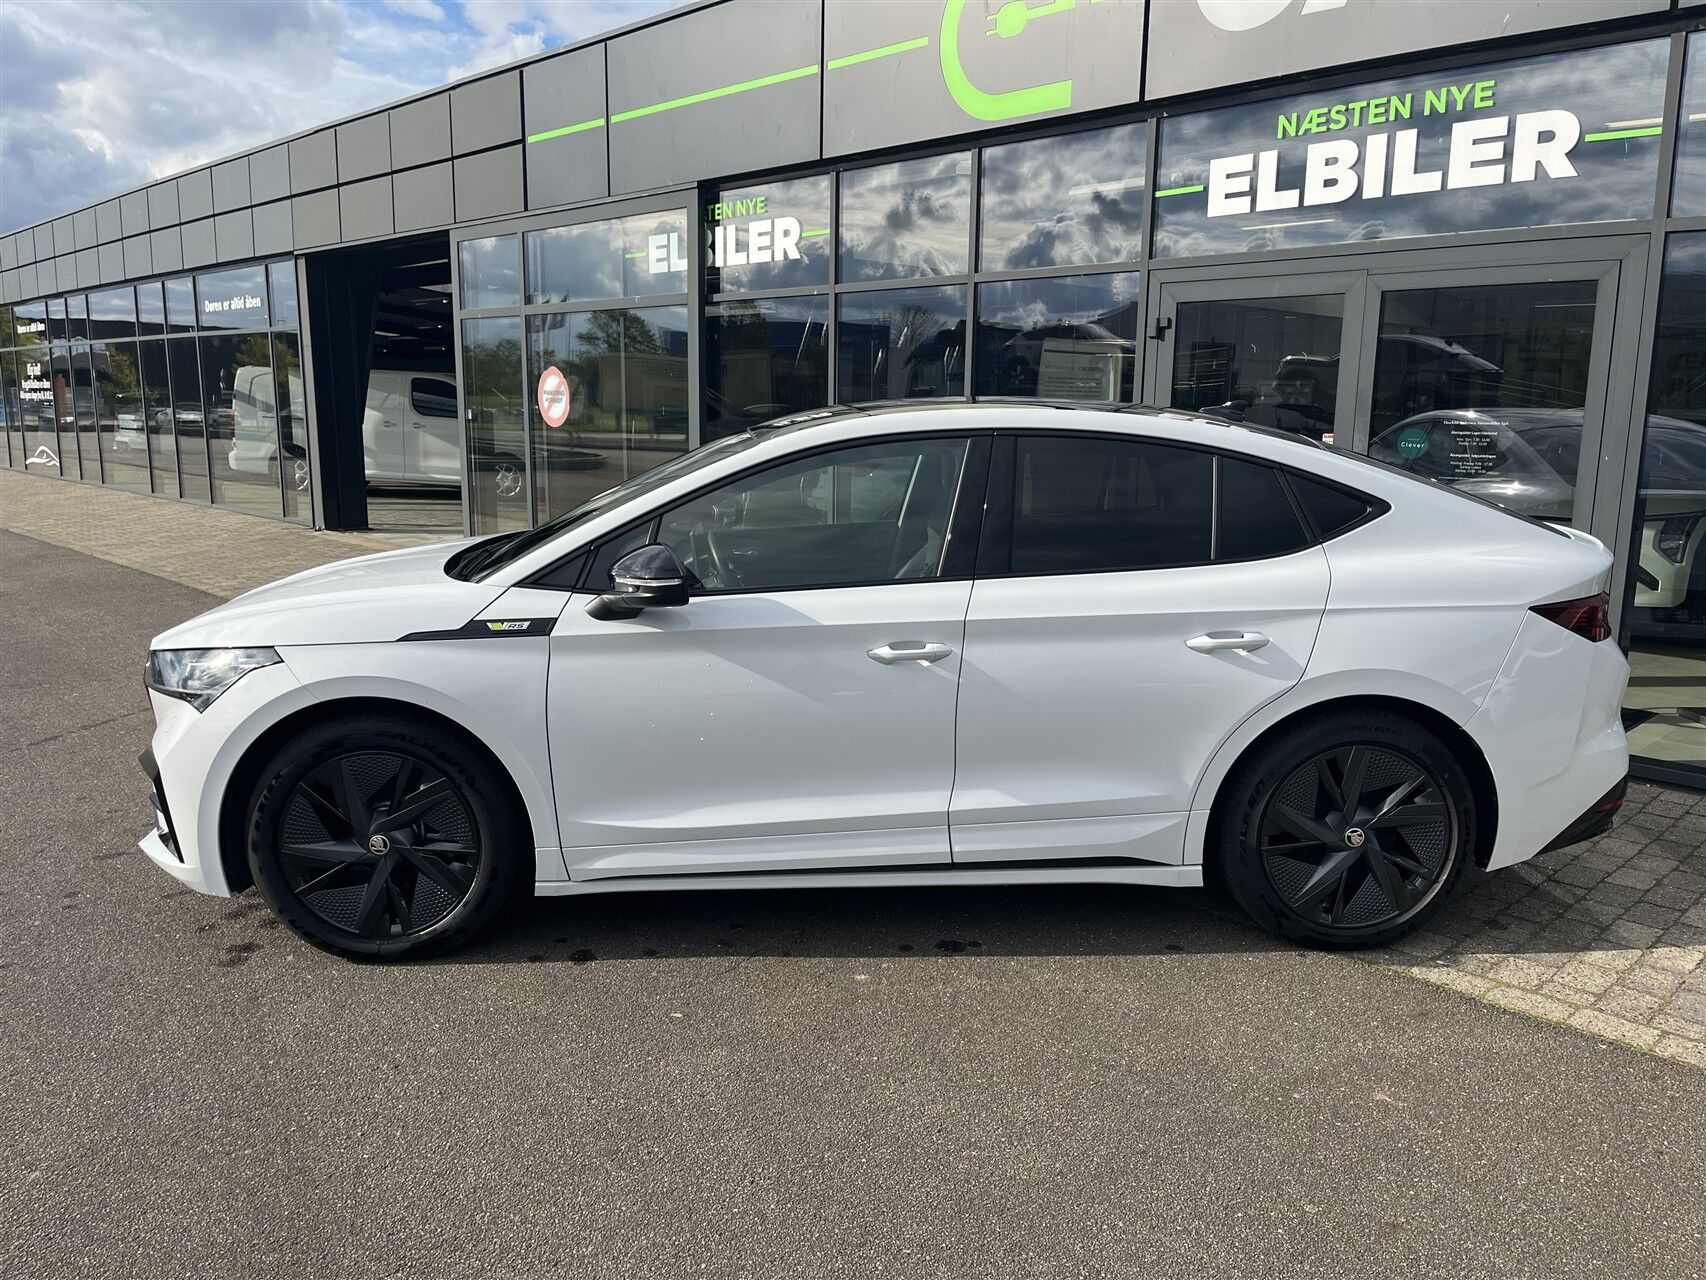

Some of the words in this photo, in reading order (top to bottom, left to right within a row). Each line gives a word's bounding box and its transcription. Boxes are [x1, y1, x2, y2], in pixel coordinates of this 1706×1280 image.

[1277, 93, 1412, 140] NÆSTEN
[1424, 80, 1496, 116] NYE
[1207, 109, 1581, 218] ELBILER
[736, 196, 766, 214] NYE
[1400, 441, 1425, 449] Clever
